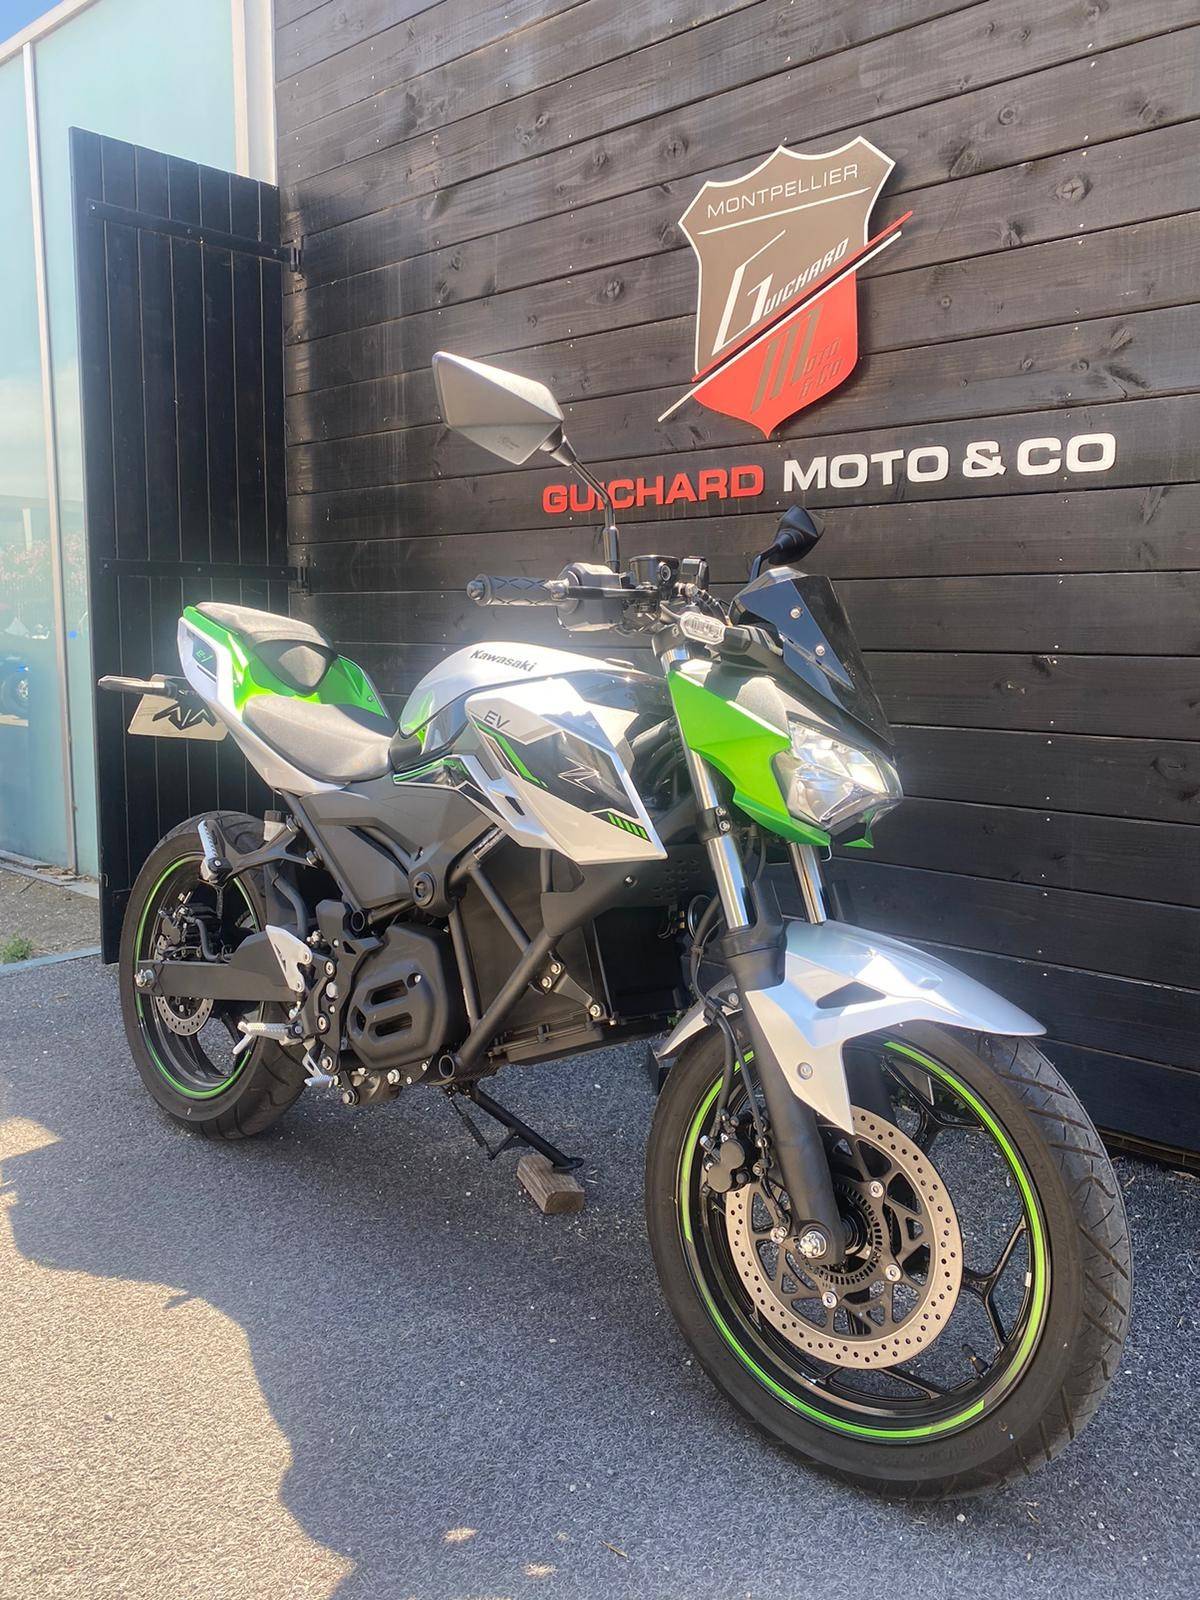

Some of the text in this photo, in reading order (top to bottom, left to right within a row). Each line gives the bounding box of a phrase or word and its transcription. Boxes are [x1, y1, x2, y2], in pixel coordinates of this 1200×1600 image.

[707, 163, 858, 219] MONTPELLIER
[711, 229, 849, 357] GUICHARD
[783, 446, 949, 492] MOTO
[962, 440, 1006, 478] &
[1017, 433, 1116, 476] CO
[470, 649, 537, 672] Kawasaki
[483, 709, 511, 729] EV
